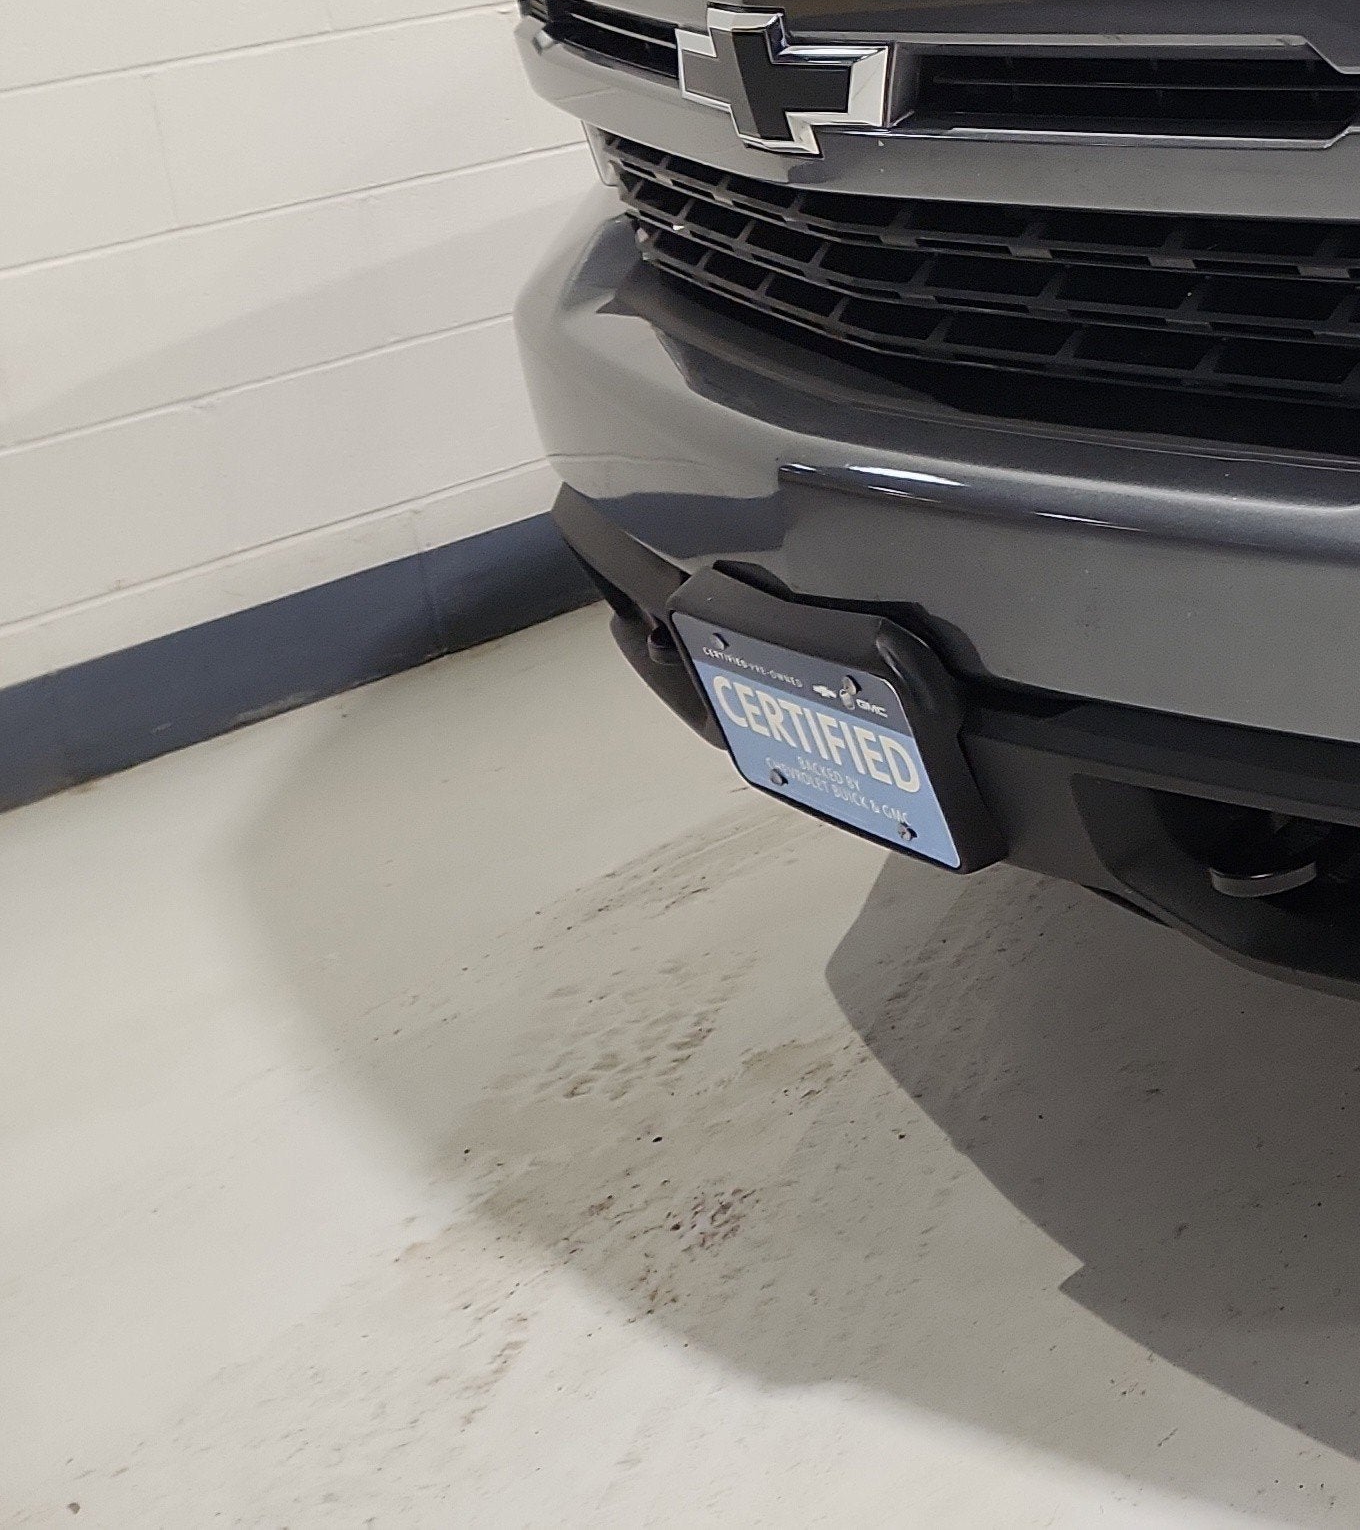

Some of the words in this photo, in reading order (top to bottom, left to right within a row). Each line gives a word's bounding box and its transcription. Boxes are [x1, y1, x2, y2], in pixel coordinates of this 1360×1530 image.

[856, 698, 888, 719] GMC
[712, 674, 920, 794] CERTIFIED
[797, 756, 844, 784] BACKED
[845, 775, 860, 792] BY
[831, 784, 869, 810] BUICK
[882, 804, 911, 827] GMC
